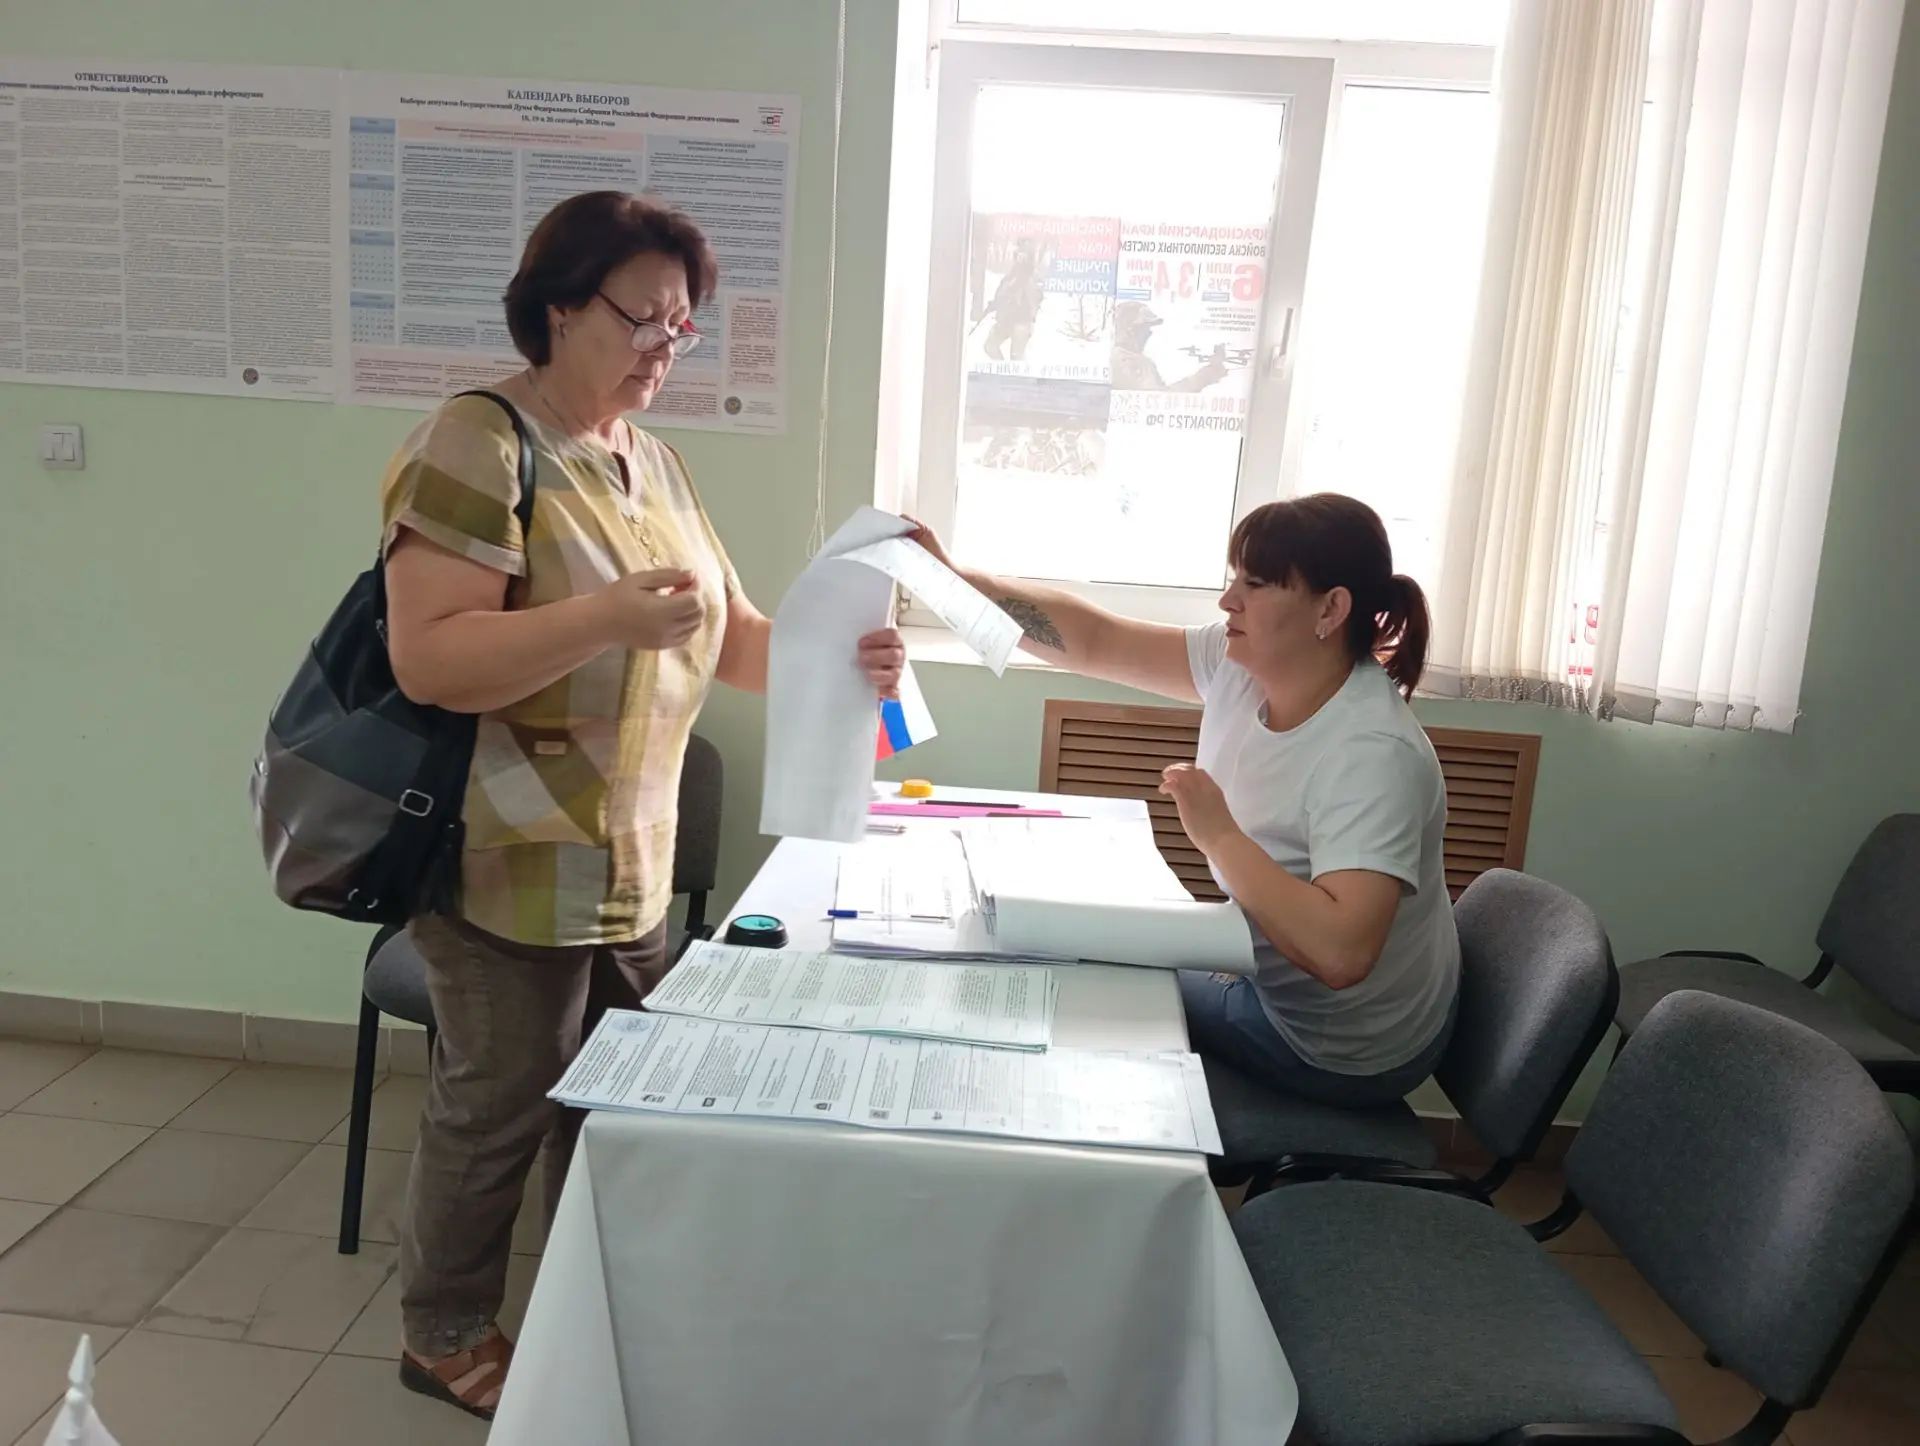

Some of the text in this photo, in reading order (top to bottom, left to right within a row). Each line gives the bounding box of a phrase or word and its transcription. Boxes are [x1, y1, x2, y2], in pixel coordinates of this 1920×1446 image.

[74, 71, 169, 85] ОТВЕТСТВЕННОСТЬ
[507, 90, 630, 106] КАЛЕНДАРЬ ВЫБОРОВ
[400, 97, 426, 108] Выборы
[459, 100, 512, 110] Государственной
[513, 103, 532, 112] Думы
[533, 104, 577, 115] Федерального
[578, 107, 611, 117] Собрания
[612, 109, 649, 119] Российской
[650, 112, 686, 121] Федерации
